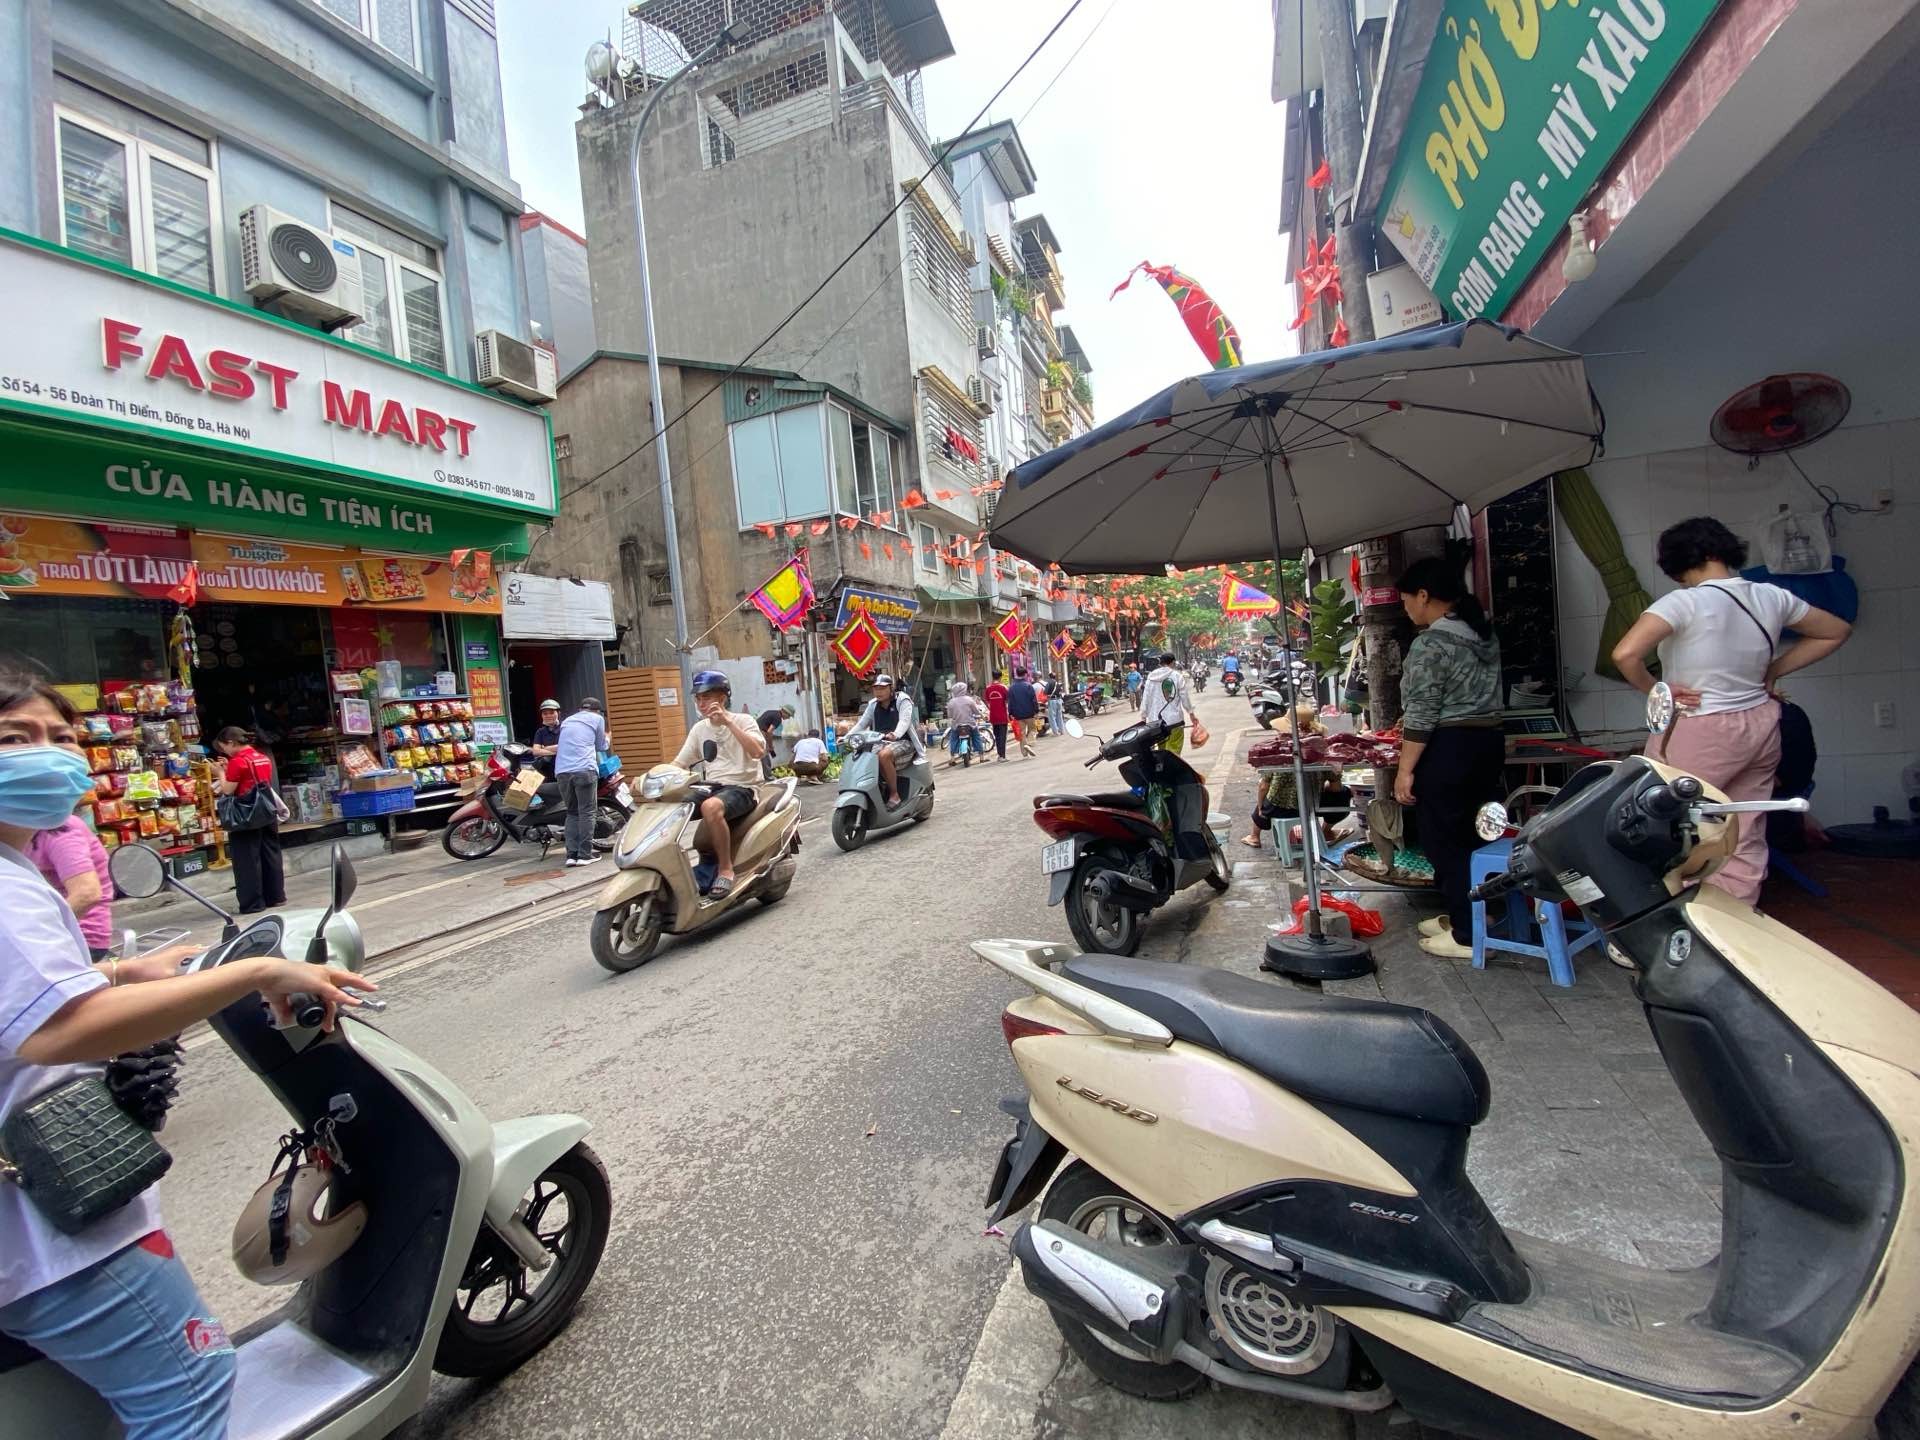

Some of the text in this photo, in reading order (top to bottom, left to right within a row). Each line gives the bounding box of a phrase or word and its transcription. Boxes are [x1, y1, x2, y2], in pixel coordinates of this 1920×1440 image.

[1425, 17, 1505, 210] PHỞ
[1451, 256, 1498, 321] CƠM
[1478, 180, 1545, 280] RANG
[1537, 82, 1598, 180] MỲ
[1, 376, 20, 392] Số
[23, 381, 41, 396] 54
[50, 385, 67, 401] 56
[71, 391, 103, 409] Đoàn
[107, 398, 127, 416] Thị
[130, 402, 162, 422] Điểm,
[165, 410, 194, 430] Đống
[197, 417, 215, 433] Đa,
[216, 421, 231, 435] Hà
[233, 426, 250, 440] Nội
[103, 319, 477, 457] FAST MART
[105, 459, 433, 534] CỬA HÀNG TIỆN ÍCH
[39, 562, 81, 581] TRAO
[1056, 1075, 1159, 1125] LEAD
